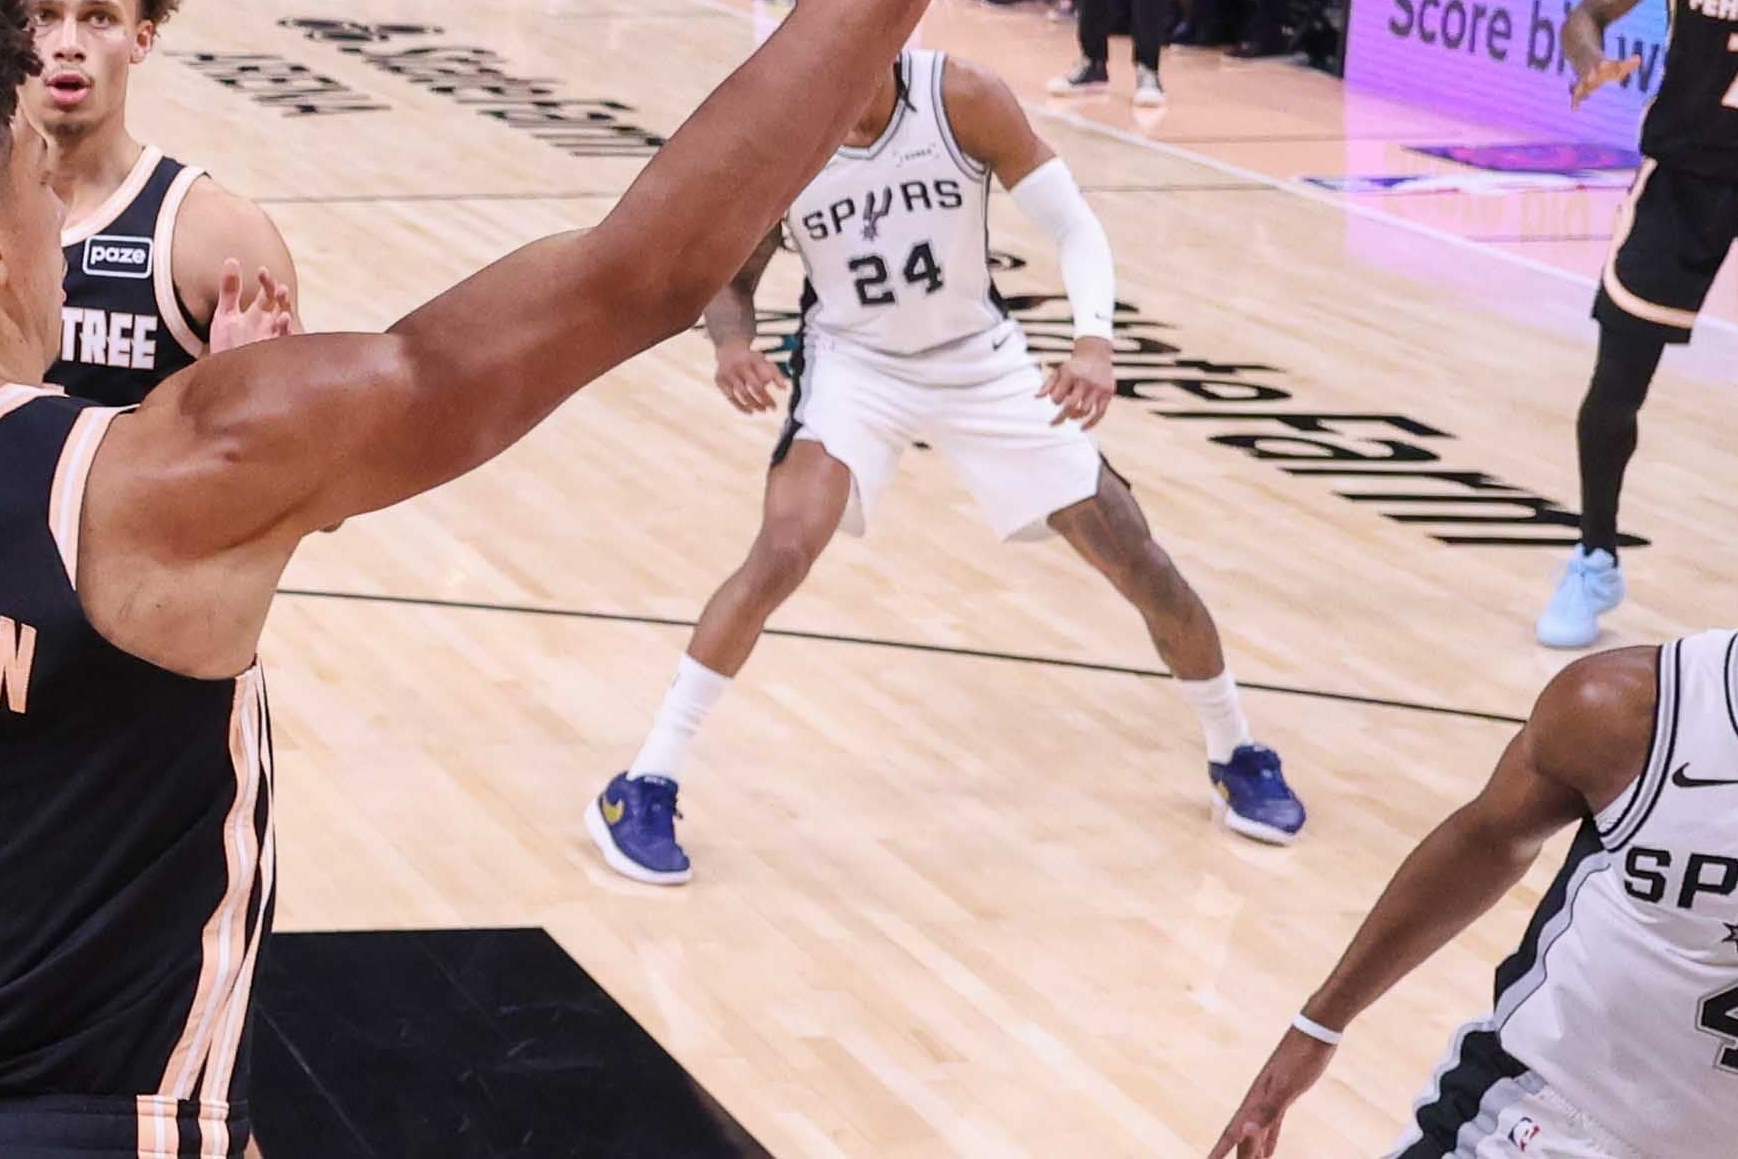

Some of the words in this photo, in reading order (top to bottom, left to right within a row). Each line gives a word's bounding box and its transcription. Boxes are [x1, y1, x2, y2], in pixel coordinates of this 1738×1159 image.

[803, 179, 963, 241] SPURS
[90, 245, 147, 266] paze
[848, 238, 945, 307] 24
